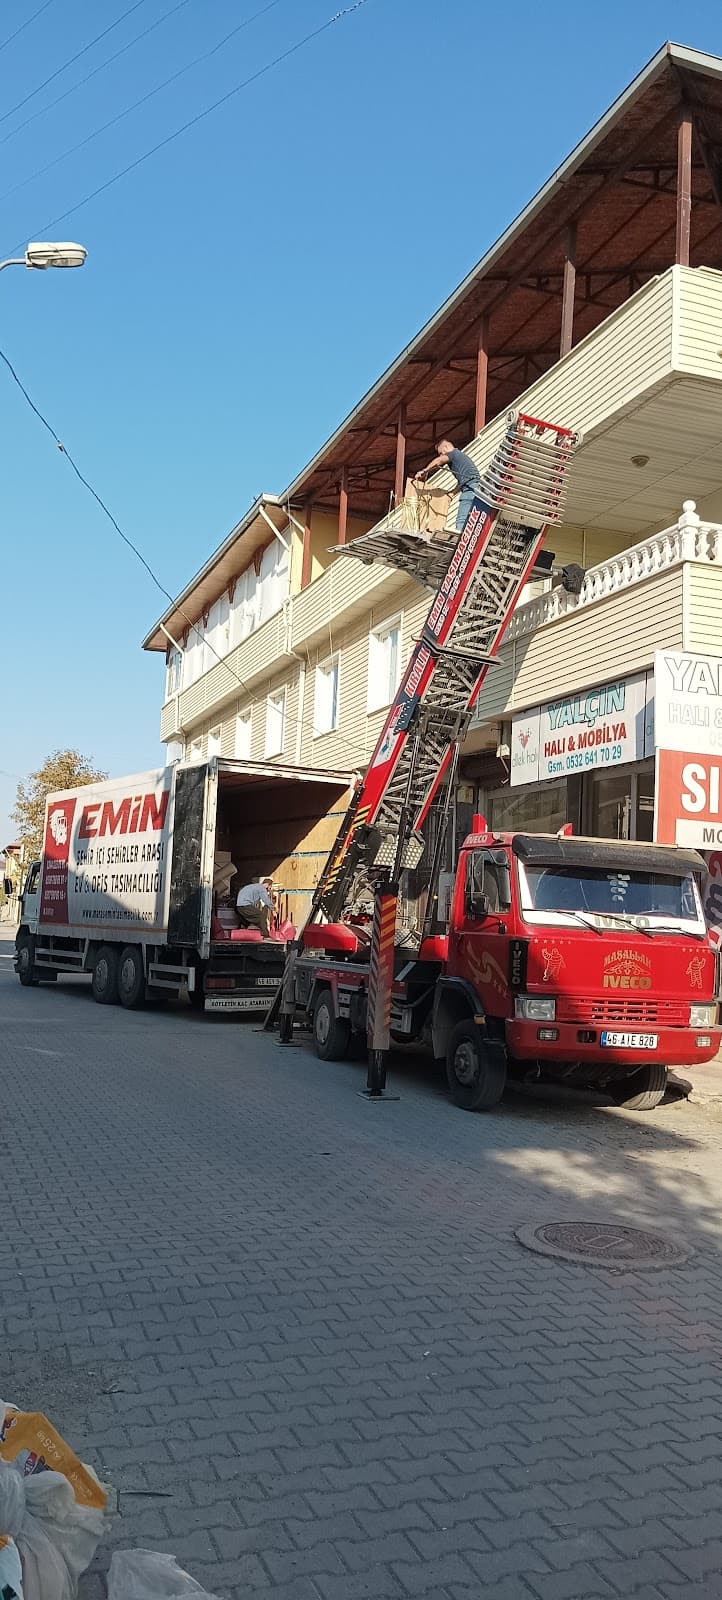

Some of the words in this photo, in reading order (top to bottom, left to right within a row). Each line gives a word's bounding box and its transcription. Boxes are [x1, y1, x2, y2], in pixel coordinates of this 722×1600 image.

[547, 682, 626, 730] YALÇIN
[544, 736, 565, 758] HALI
[568, 736, 575, 752] &
[578, 722, 626, 749] MOBİLYA
[547, 760, 564, 773] Gsm.
[566, 753, 583, 769] 0532
[585, 750, 597, 766] 641
[601, 748, 609, 762] 70
[612, 744, 621, 759] 29
[141, 841, 164, 862] ARASI
[603, 975, 652, 989] IVECO
